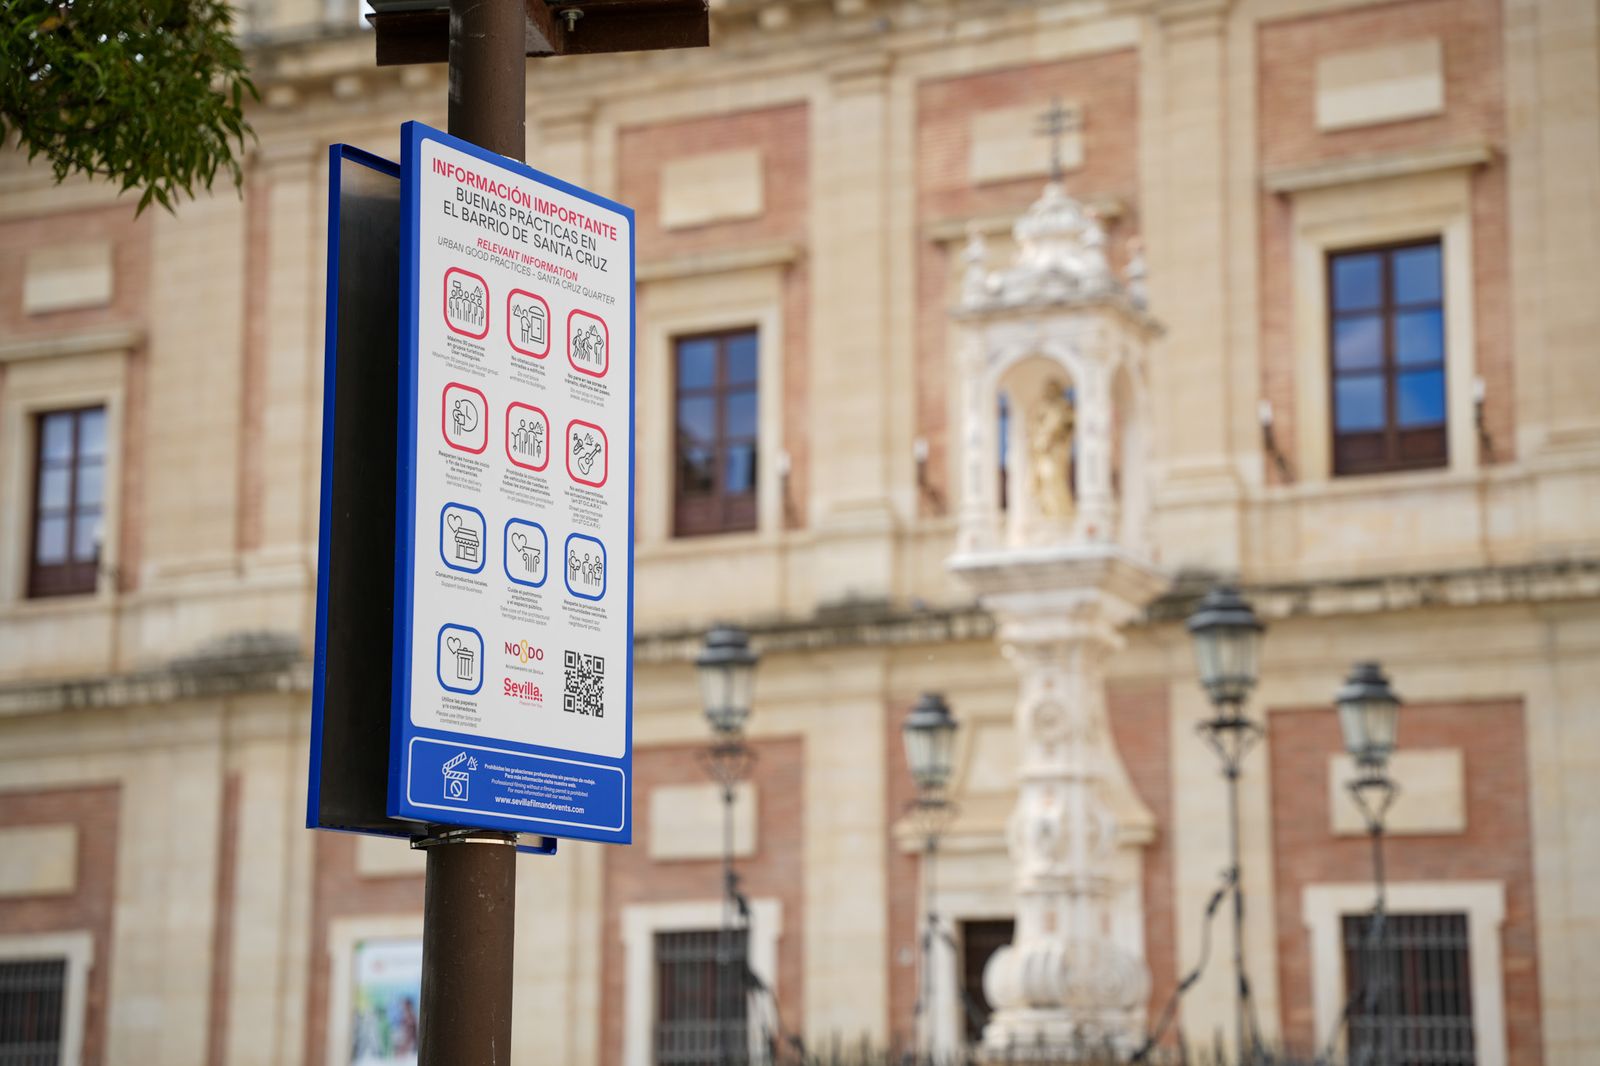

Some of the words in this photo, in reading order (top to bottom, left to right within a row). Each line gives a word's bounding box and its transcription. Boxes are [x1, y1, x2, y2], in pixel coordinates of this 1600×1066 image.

[433, 157, 531, 209] INFORMACIÓN
[534, 197, 617, 241] IMPORTANTE
[456, 187, 507, 218] BUENAS
[509, 207, 579, 245] PRÁCTICAS
[581, 234, 597, 251] EN
[443, 200, 459, 219] EL
[461, 207, 509, 236] BARRIO
[512, 226, 528, 244] DE
[533, 234, 574, 260] SANTA
[575, 249, 608, 272] CRUZ
[477, 237, 520, 260] RELEVANT
[521, 255, 579, 282] INFORMATION
[437, 236, 464, 252] URBAN
[465, 245, 489, 261] GOOD
[490, 254, 531, 278] PRACTICES
[536, 272, 561, 288] SANTA
[562, 279, 581, 293] CRUZ
[582, 286, 616, 306] QUARTER
[435, 570, 453, 580] Consuma
[454, 575, 474, 584] productos
